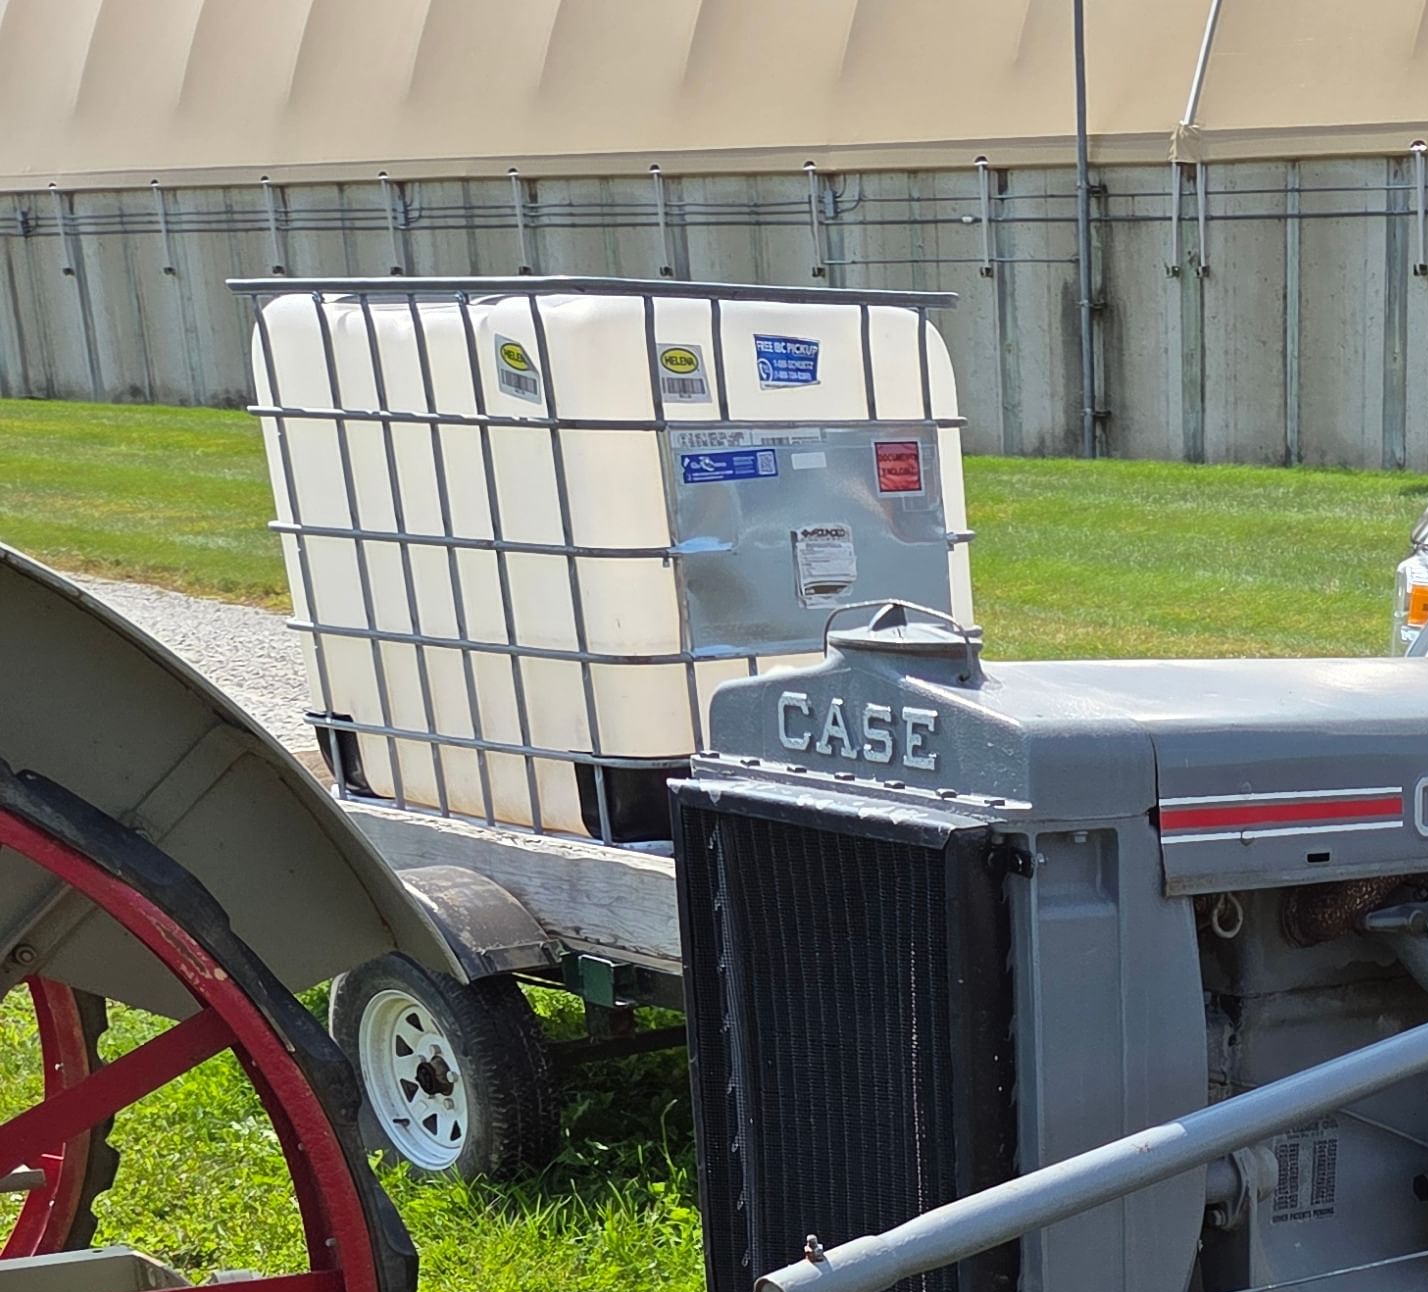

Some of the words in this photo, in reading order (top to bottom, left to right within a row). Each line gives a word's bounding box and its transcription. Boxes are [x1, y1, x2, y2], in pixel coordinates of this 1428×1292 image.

[756, 340, 774, 353] FREE
[786, 342, 818, 356] PICKUP
[664, 355, 696, 367] HELENA
[778, 691, 938, 770] CASE
